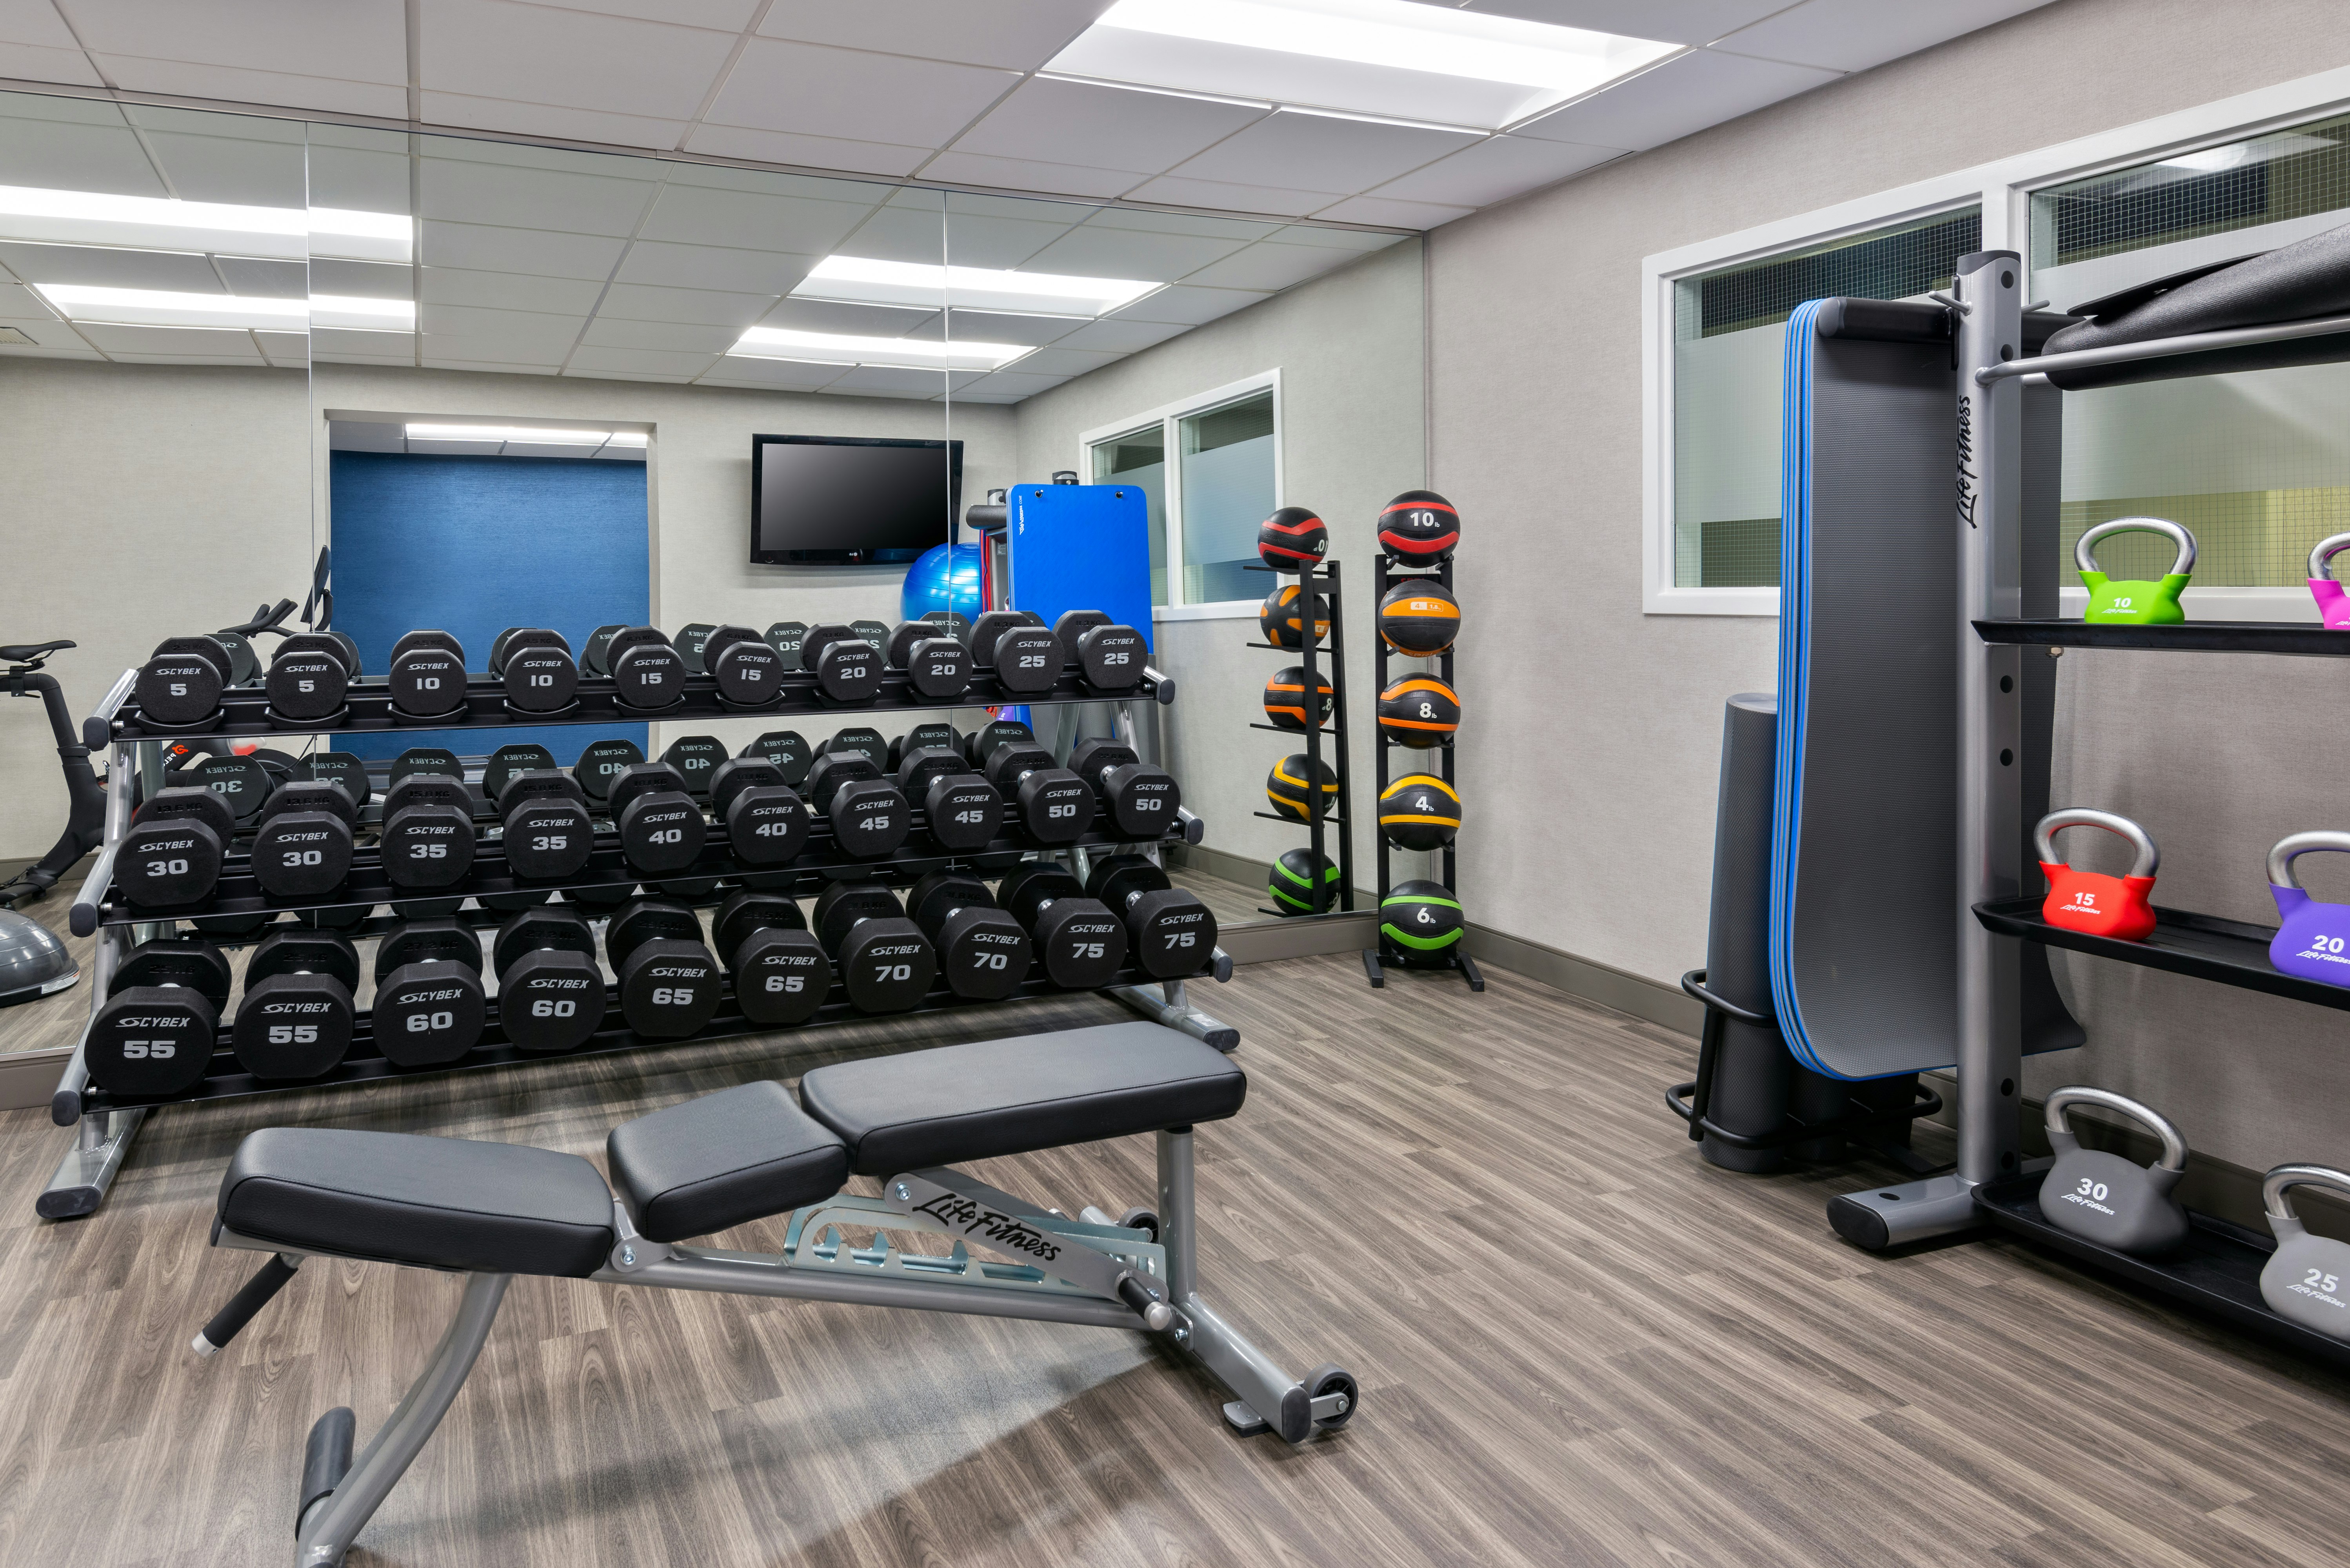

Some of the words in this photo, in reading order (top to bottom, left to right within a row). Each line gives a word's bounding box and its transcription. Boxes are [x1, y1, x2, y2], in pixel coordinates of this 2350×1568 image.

[2114, 598, 2131, 608] 10
[1020, 656, 1045, 667] 25
[1104, 653, 1129, 664] 25
[742, 669, 761, 680] 15
[841, 667, 865, 679] 20
[932, 665, 955, 675] 20
[417, 678, 439, 690] 10
[531, 675, 552, 686] 10
[642, 673, 662, 684] 15
[171, 684, 186, 695] 5
[299, 681, 314, 692] 5
[867, 800, 894, 809] CYBEX
[1136, 799, 1161, 810] 50
[657, 812, 687, 821] CYBEX
[955, 811, 983, 823] 45
[1049, 805, 1076, 817] 50
[860, 816, 889, 830] 45
[756, 823, 786, 836] 40
[293, 832, 328, 841] CYBEX
[649, 829, 681, 844] 40
[156, 840, 194, 850] CYBEX
[533, 836, 566, 850] 35
[410, 844, 446, 858] 35
[283, 851, 321, 866] 30
[147, 859, 188, 876] 30
[2075, 893, 2095, 906] 15
[1174, 914, 1204, 924] CYBEX
[987, 934, 1020, 945] CYBEX
[1165, 932, 1195, 949] 75
[2312, 935, 2344, 953] 20
[885, 945, 921, 955] CYBEX
[1073, 944, 1104, 958] 75
[780, 956, 817, 965] CYBEX
[974, 953, 1007, 969] 70
[667, 968, 707, 977] CYBEX
[876, 965, 911, 982] 70
[547, 980, 589, 988] CYBEX
[766, 976, 804, 991] 65
[418, 989, 462, 1001] CYBEX
[652, 988, 693, 1004] 65
[284, 1003, 331, 1012] CYBEX
[532, 1000, 575, 1016] 60
[140, 1018, 190, 1027] CYBEX
[407, 1012, 452, 1031] 60
[269, 1026, 318, 1043] 55
[124, 1041, 175, 1058] 55
[2077, 1178, 2108, 1201] 30
[2303, 1268, 2339, 1292] 25
